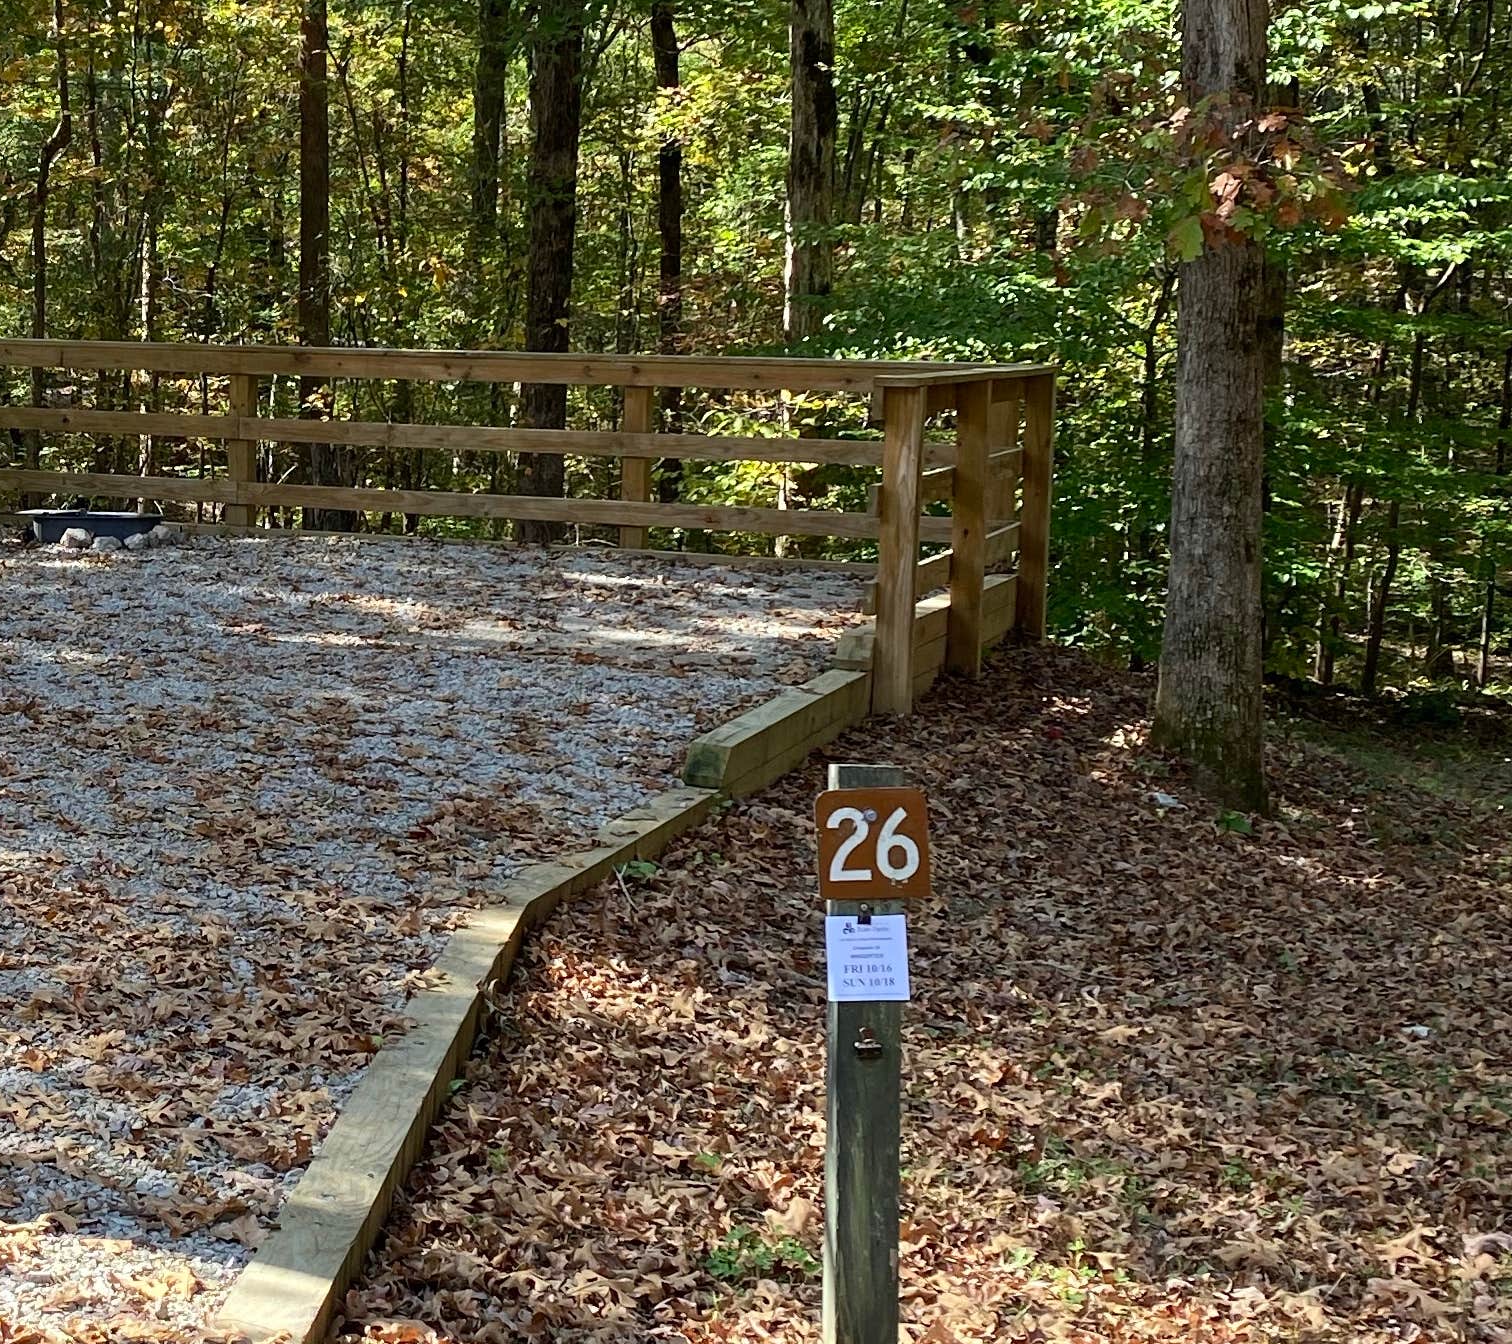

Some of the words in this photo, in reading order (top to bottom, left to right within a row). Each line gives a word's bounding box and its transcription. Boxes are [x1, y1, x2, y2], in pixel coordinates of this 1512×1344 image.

[826, 806, 920, 882] 26
[843, 964, 863, 974] FRI
[866, 964, 893, 973] 10/16
[842, 978, 866, 987] SUN
[869, 977, 896, 987] 10/18
